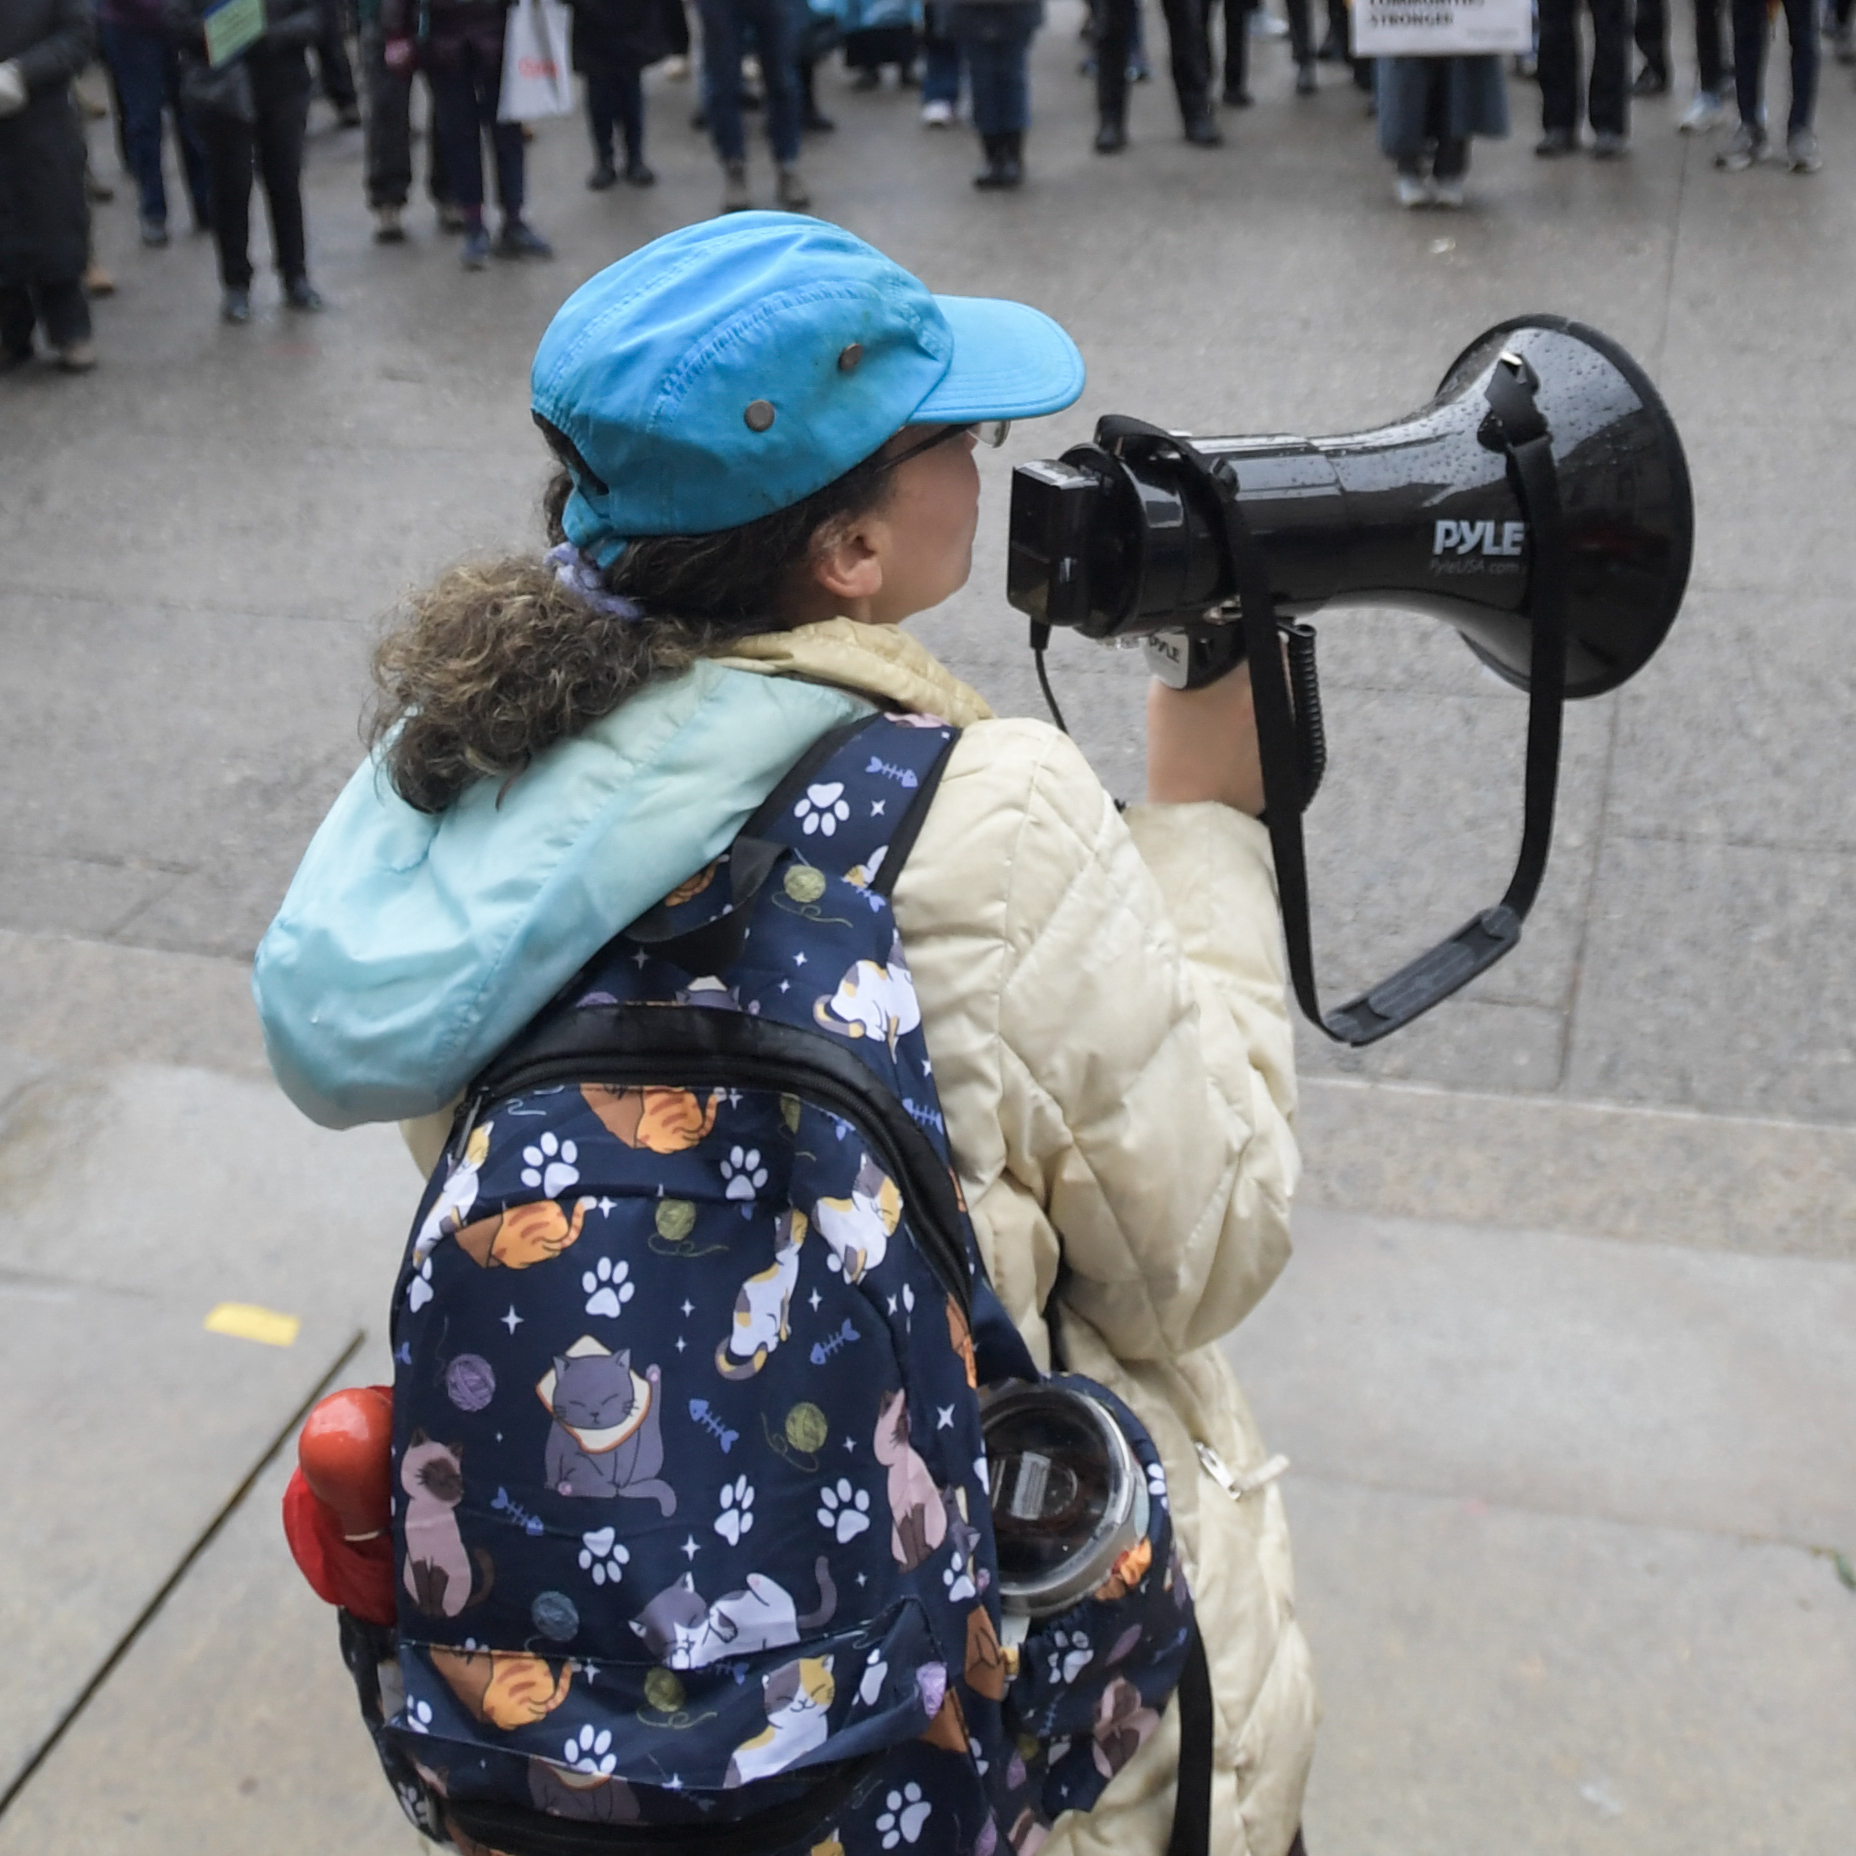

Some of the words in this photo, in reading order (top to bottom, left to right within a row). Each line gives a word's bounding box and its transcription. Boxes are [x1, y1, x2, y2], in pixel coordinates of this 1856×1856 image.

[1369, 12, 1455, 27] STRONGER
[1433, 520, 1525, 557] PYLE
[1148, 635, 1181, 664] PYLE
